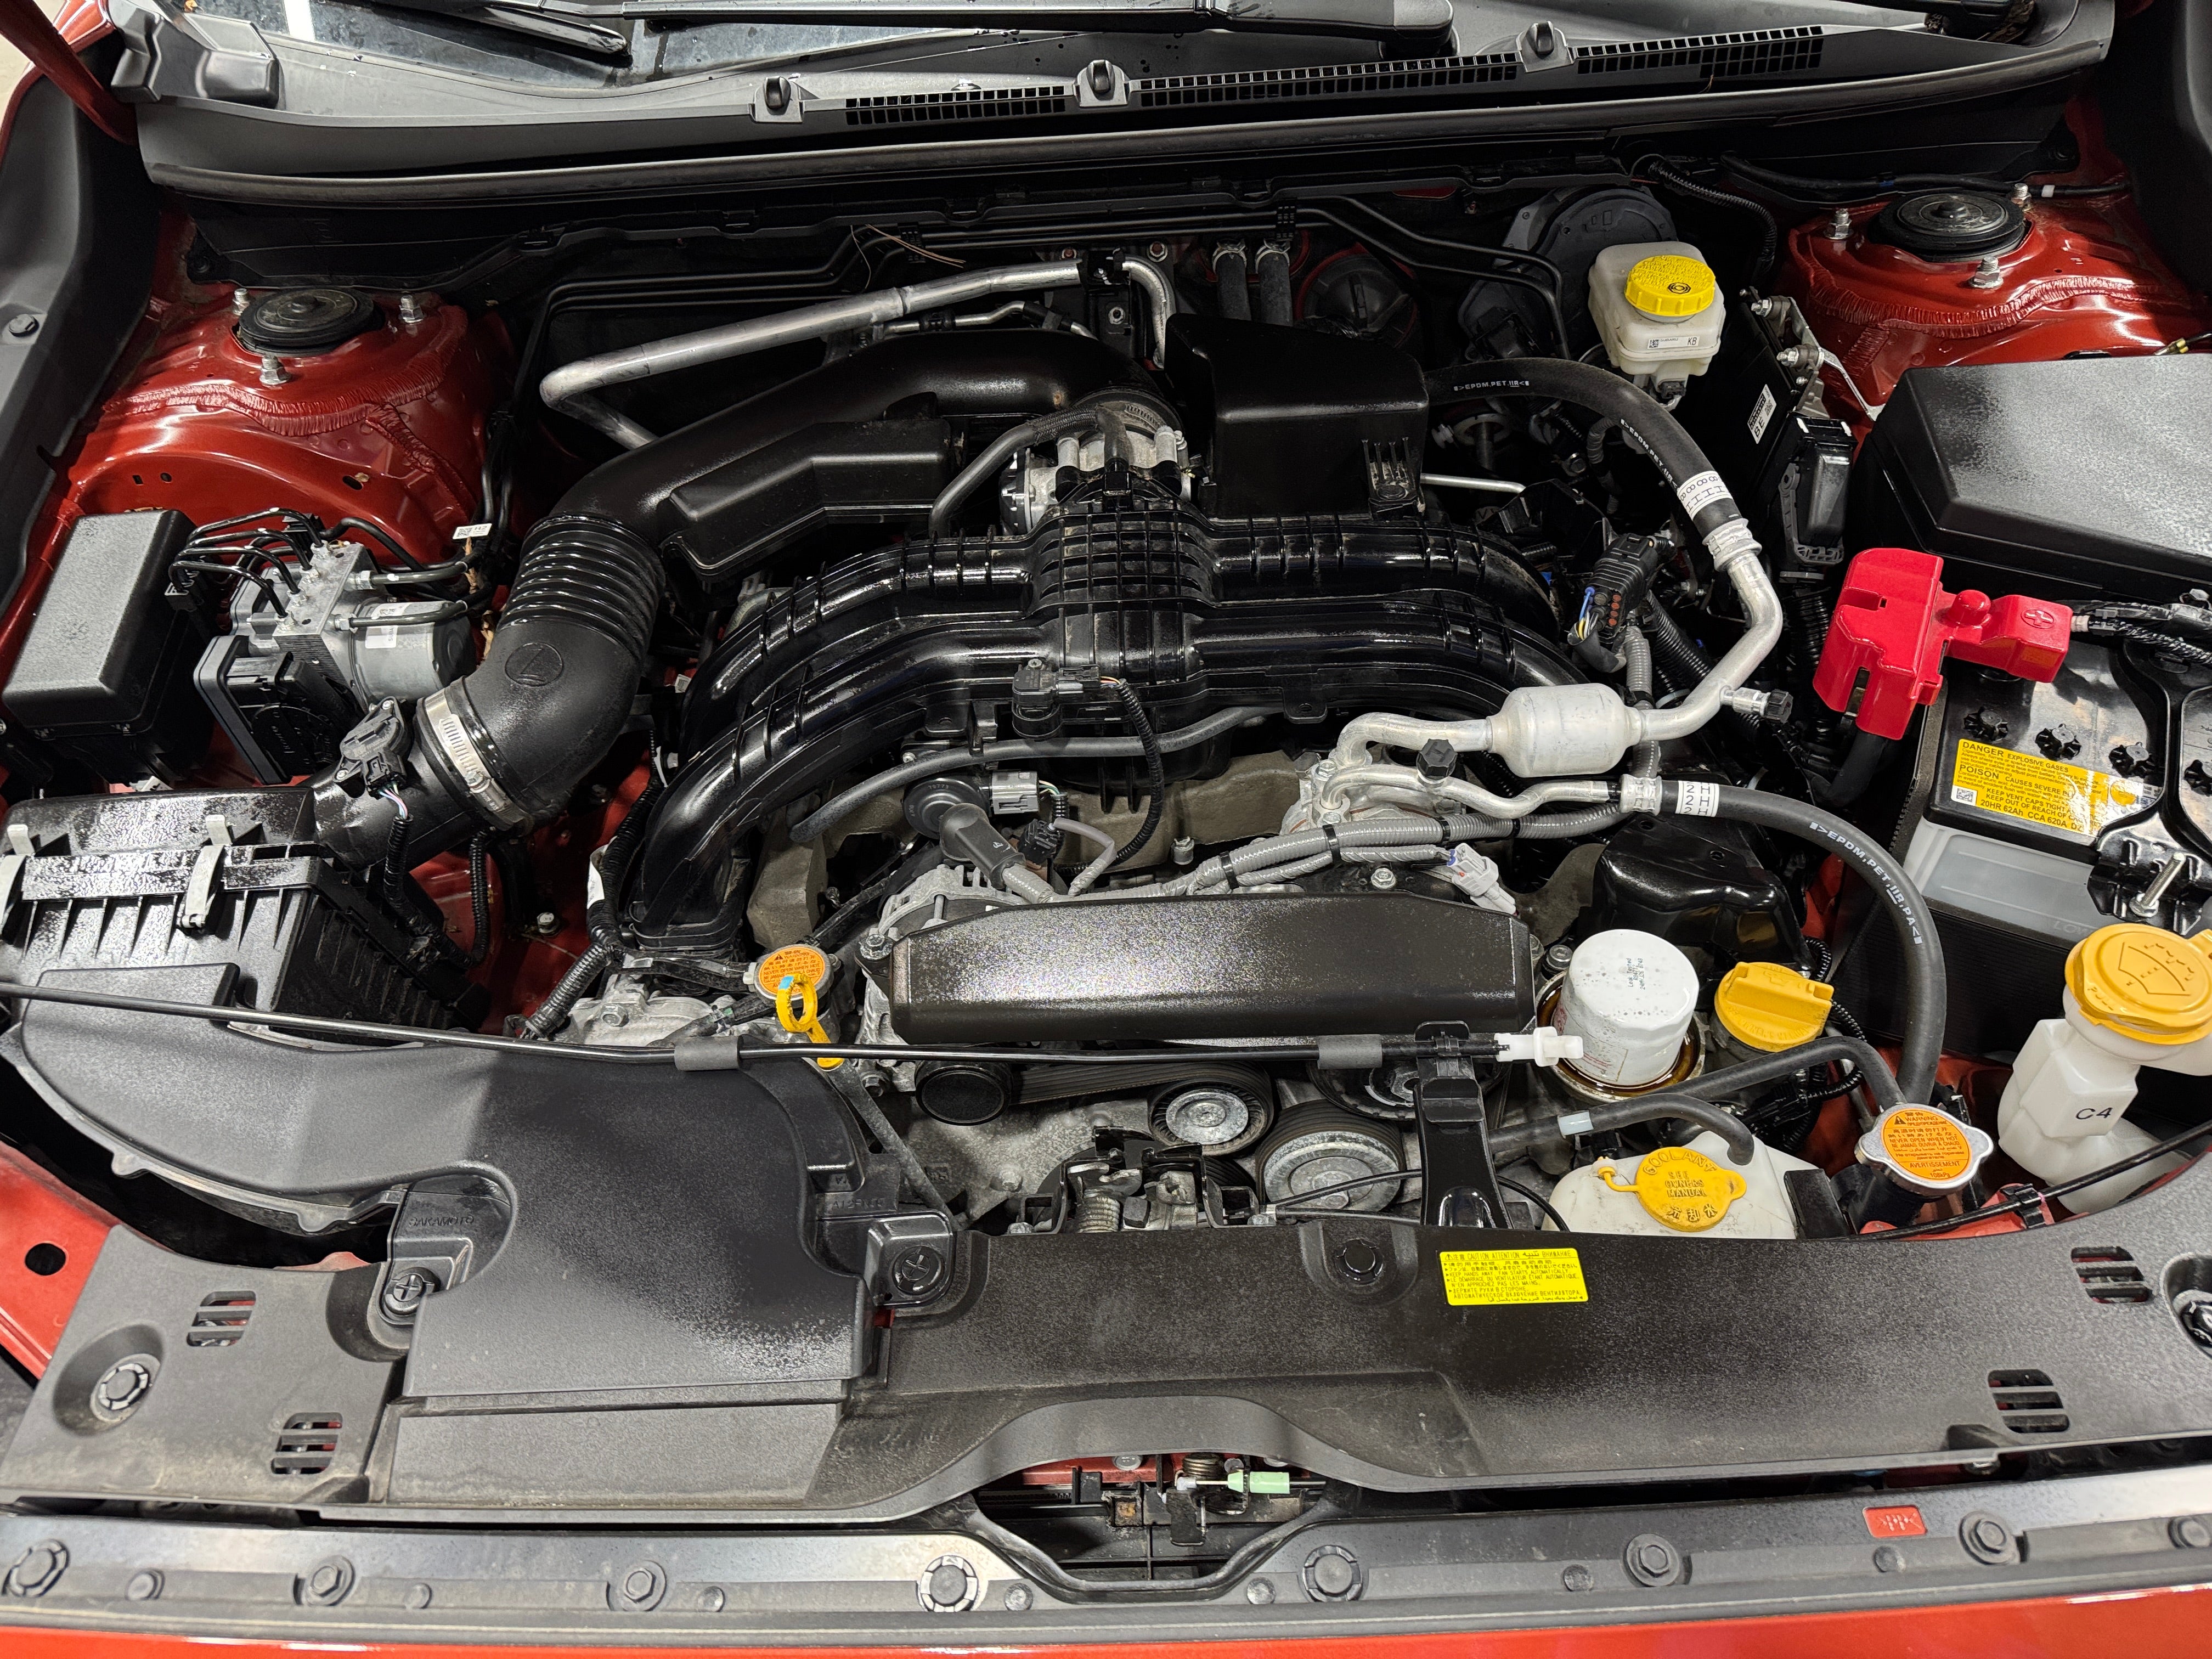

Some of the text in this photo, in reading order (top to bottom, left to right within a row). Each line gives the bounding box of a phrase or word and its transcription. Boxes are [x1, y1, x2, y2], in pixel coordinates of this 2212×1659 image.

[1688, 337, 1697, 346] KB
[1962, 741, 2069, 773] DANGER EXPLOSIVE GASES
[1959, 764, 1999, 780] POISON
[2005, 776, 2032, 787] CAUSES
[2034, 783, 2061, 794] SEVERE
[1686, 785, 1710, 794] 2 H
[1685, 795, 1710, 806] 2 H
[1985, 793, 2004, 802] KEEP
[2032, 805, 2056, 816] REACH
[1987, 787, 2004, 797] KEEP
[2005, 792, 2023, 802] VENT
[2025, 797, 2044, 806] CAPS
[2045, 802, 2064, 812] TIGHT
[1980, 799, 2001, 810] 20HR
[2003, 805, 2023, 816] 62Ah
[2027, 811, 2046, 822] CCA
[2047, 816, 2067, 827] 620A
[2075, 1107, 2113, 1120] C4
[1668, 1171, 1689, 1180] SEE
[1667, 1189, 1708, 1198] MANUAL
[409, 1216, 474, 1227] SAKAMOTO
